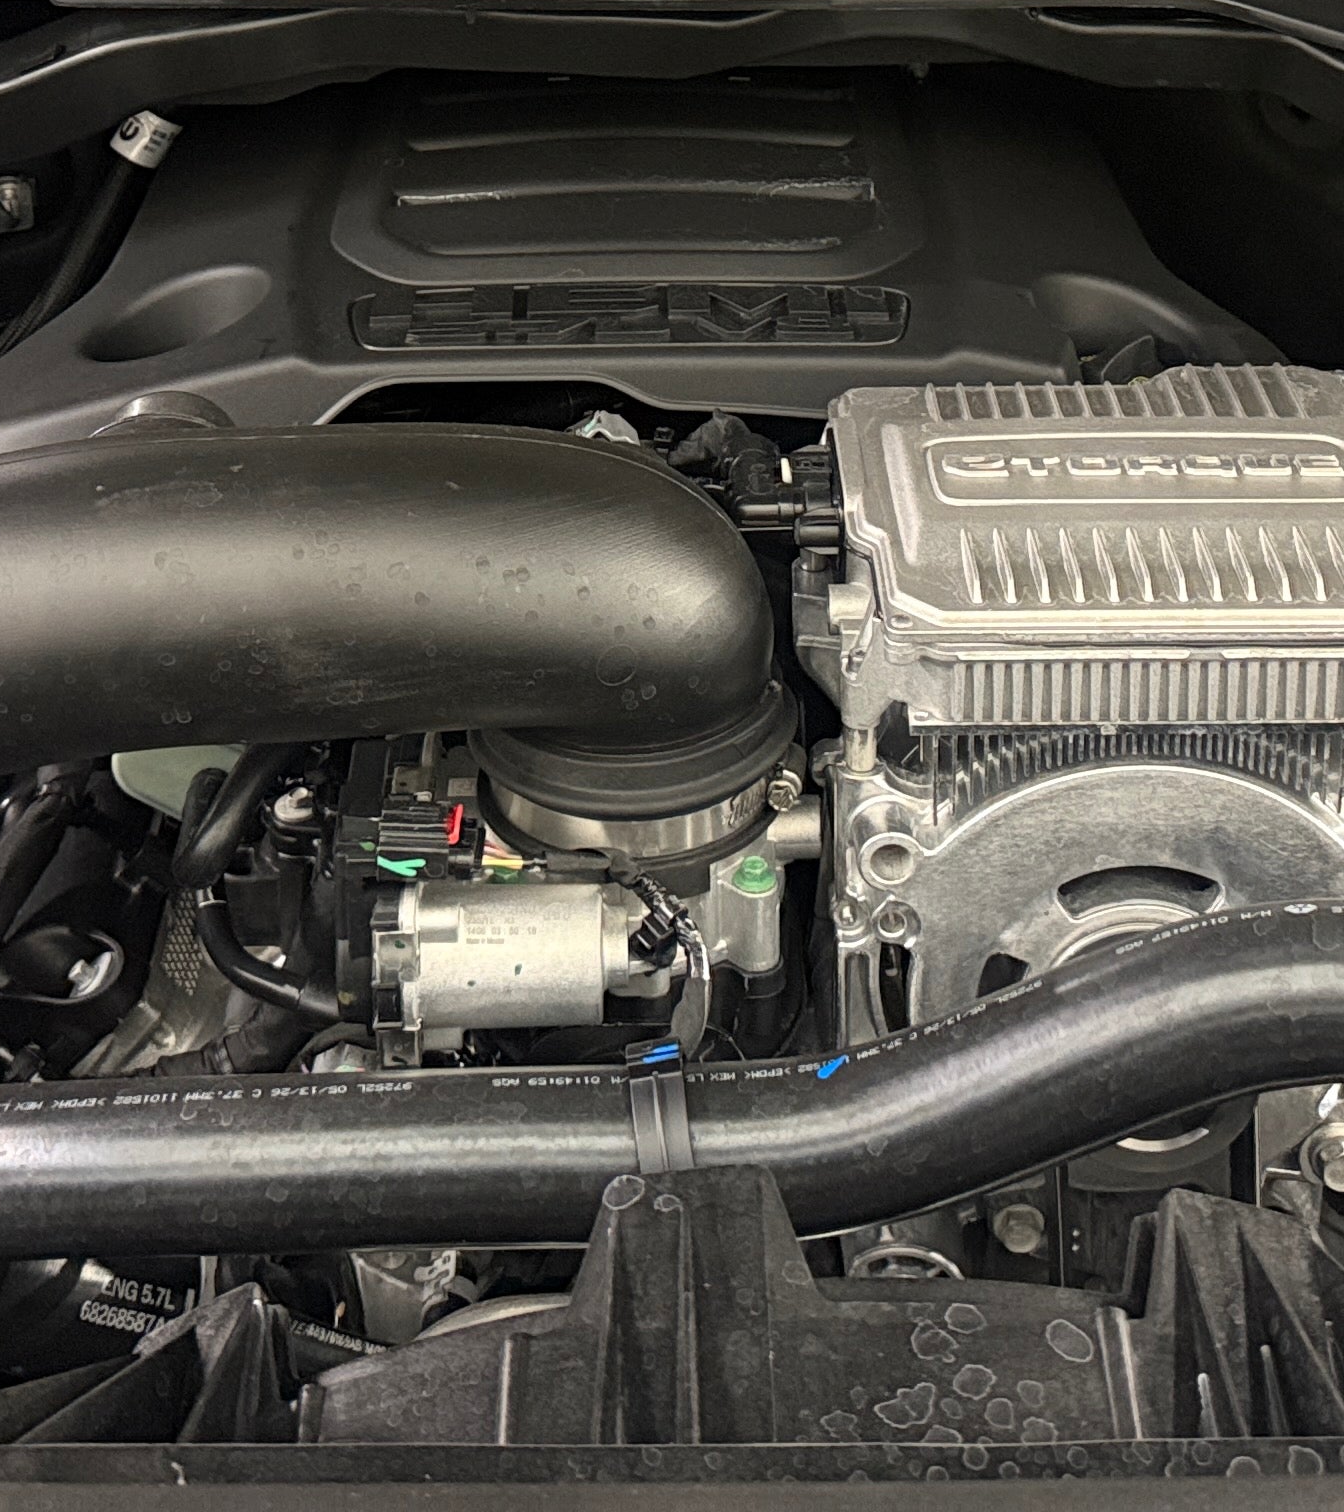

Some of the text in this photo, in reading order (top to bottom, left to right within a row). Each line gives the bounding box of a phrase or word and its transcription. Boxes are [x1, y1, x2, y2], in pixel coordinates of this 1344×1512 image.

[709, 1072, 736, 1082] MEX
[270, 1085, 348, 1097] 05/13/26
[101, 1276, 176, 1311] ENG 5.7L
